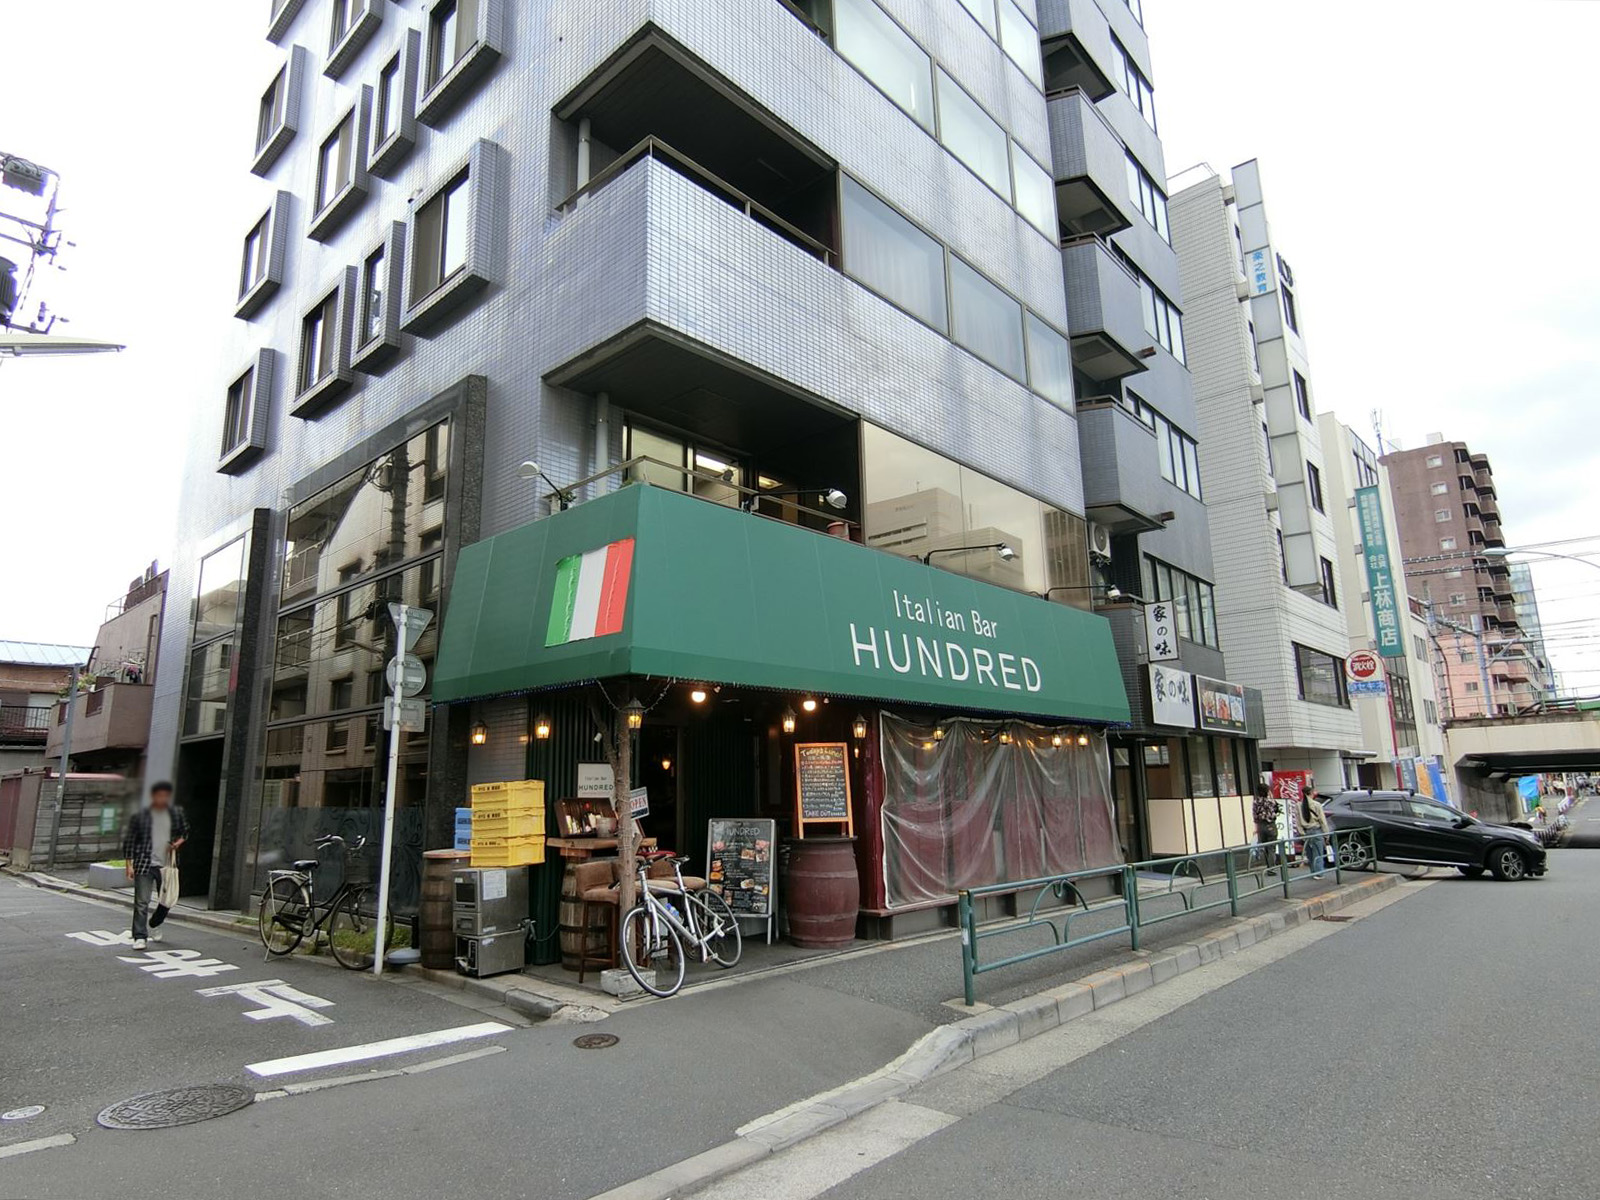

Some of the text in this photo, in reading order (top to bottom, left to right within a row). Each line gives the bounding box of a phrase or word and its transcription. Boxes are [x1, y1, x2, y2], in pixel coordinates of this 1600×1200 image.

[893, 589, 998, 639] Italian Bar
[1153, 605, 1172, 656] 家の味
[1373, 572, 1398, 647] 上林商店
[849, 623, 1042, 692] HUNDRED
[1155, 667, 1190, 705] 家の味
